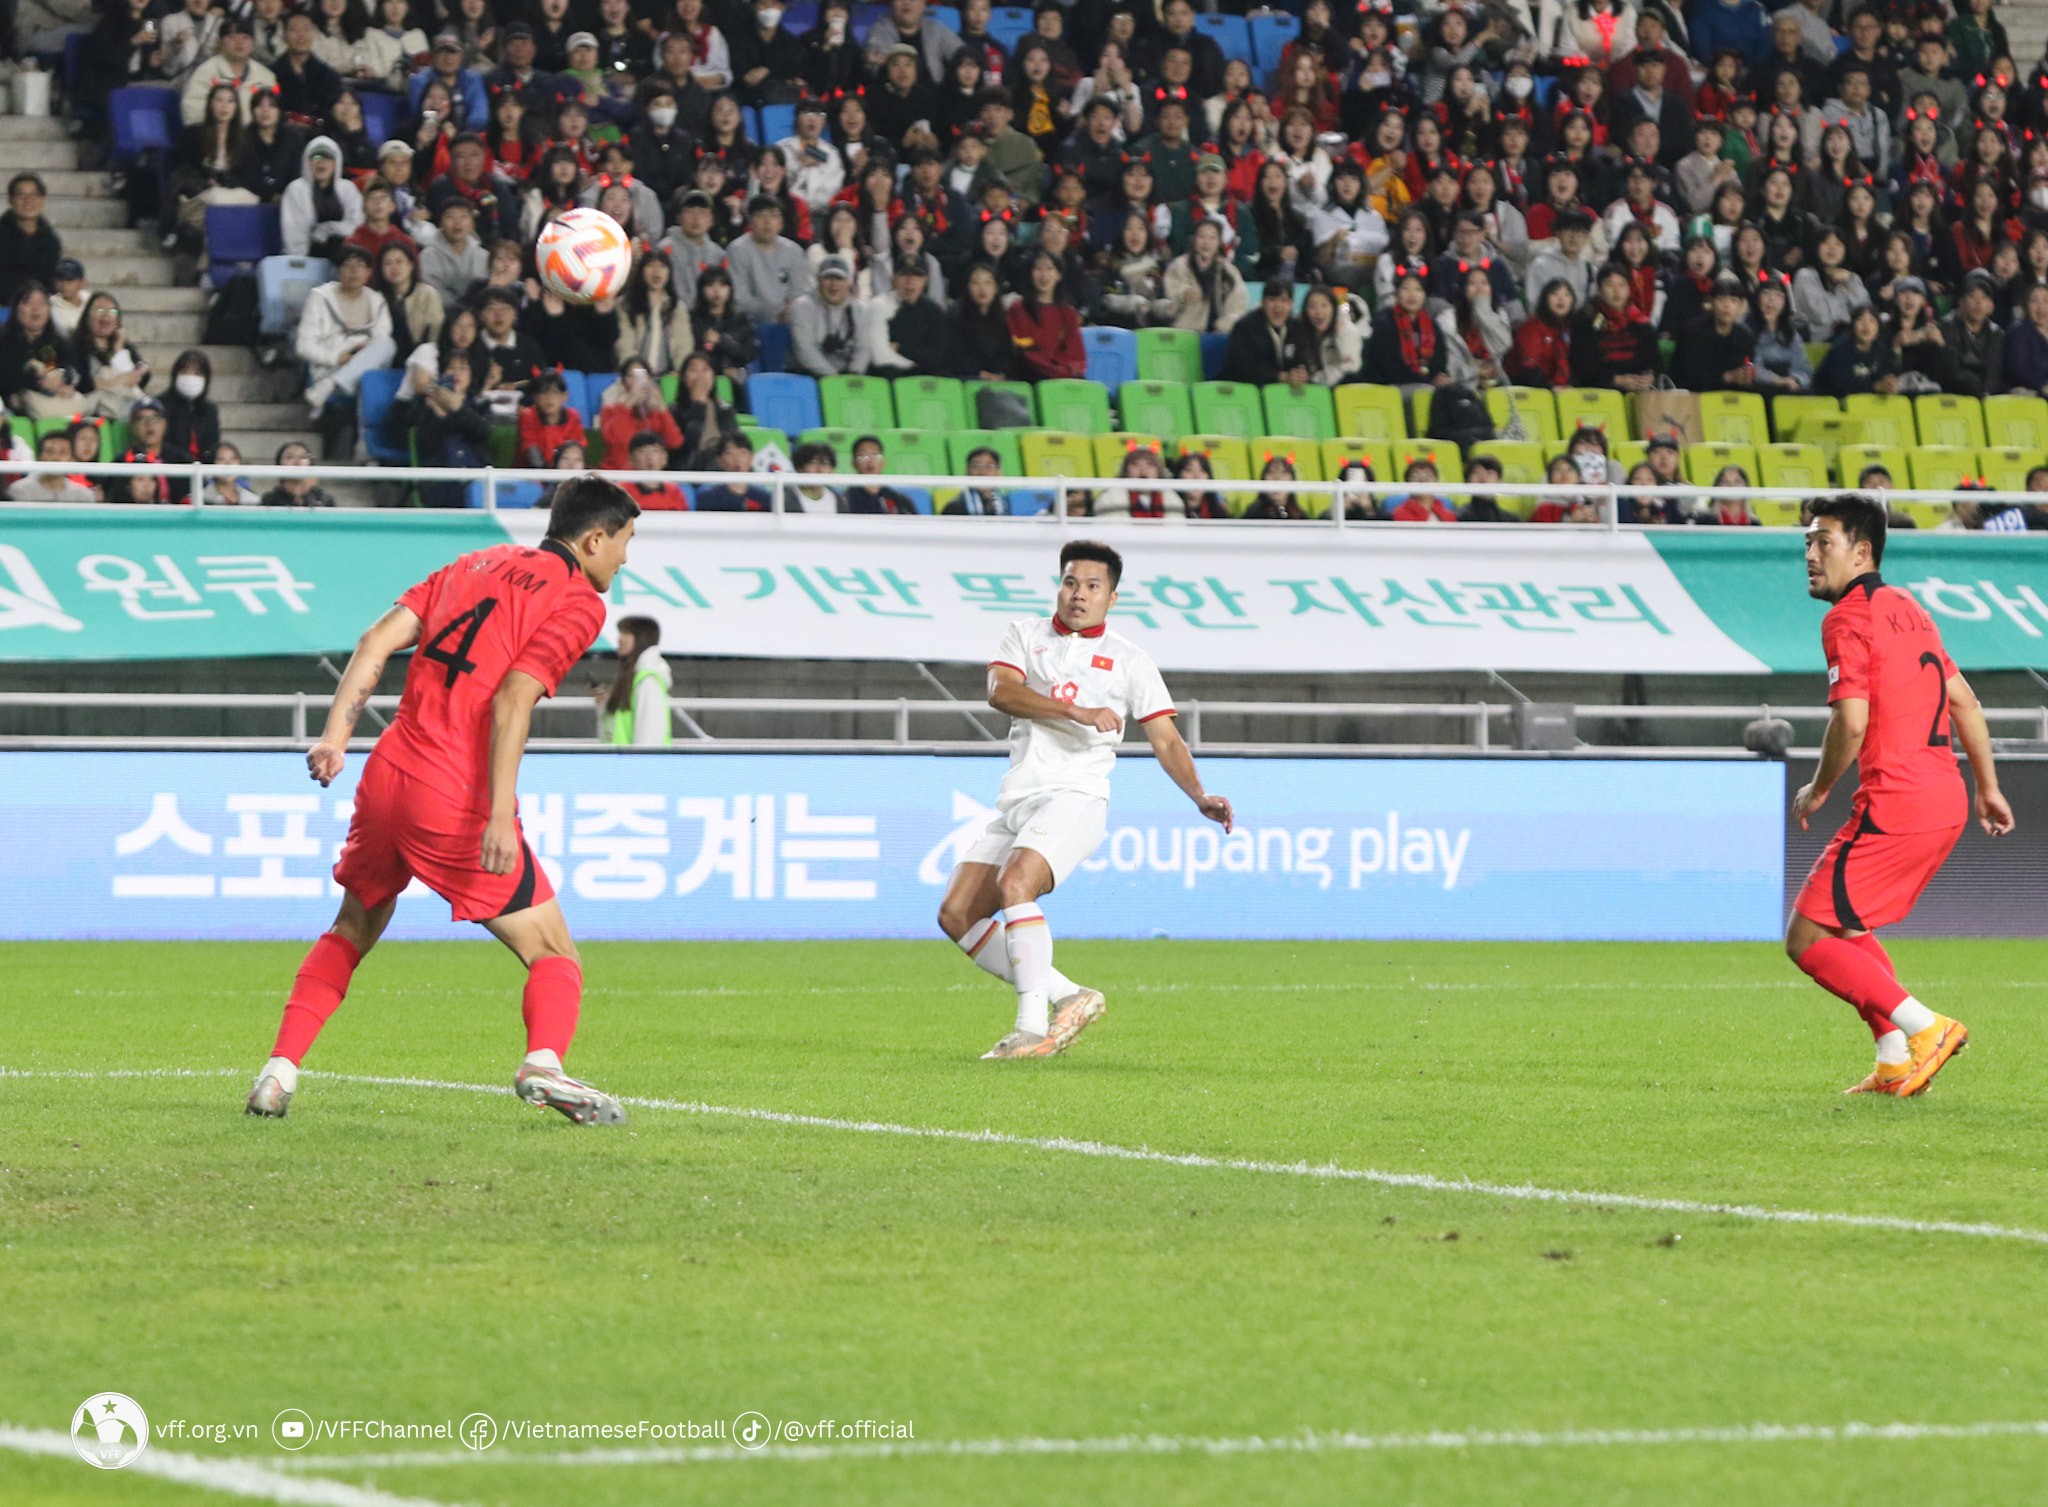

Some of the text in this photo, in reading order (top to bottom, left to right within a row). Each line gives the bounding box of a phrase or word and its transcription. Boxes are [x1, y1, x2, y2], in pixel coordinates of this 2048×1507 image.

[76, 554, 316, 621] 원큐
[500, 565, 548, 594] KIM
[610, 565, 713, 608] AI
[720, 564, 934, 619] 기반
[1267, 576, 1674, 635] 자산관리
[1906, 576, 2048, 638] 하
[424, 596, 498, 689] 4
[1919, 651, 1950, 747] 2
[112, 792, 431, 898] 스포
[1350, 810, 1471, 891] play
